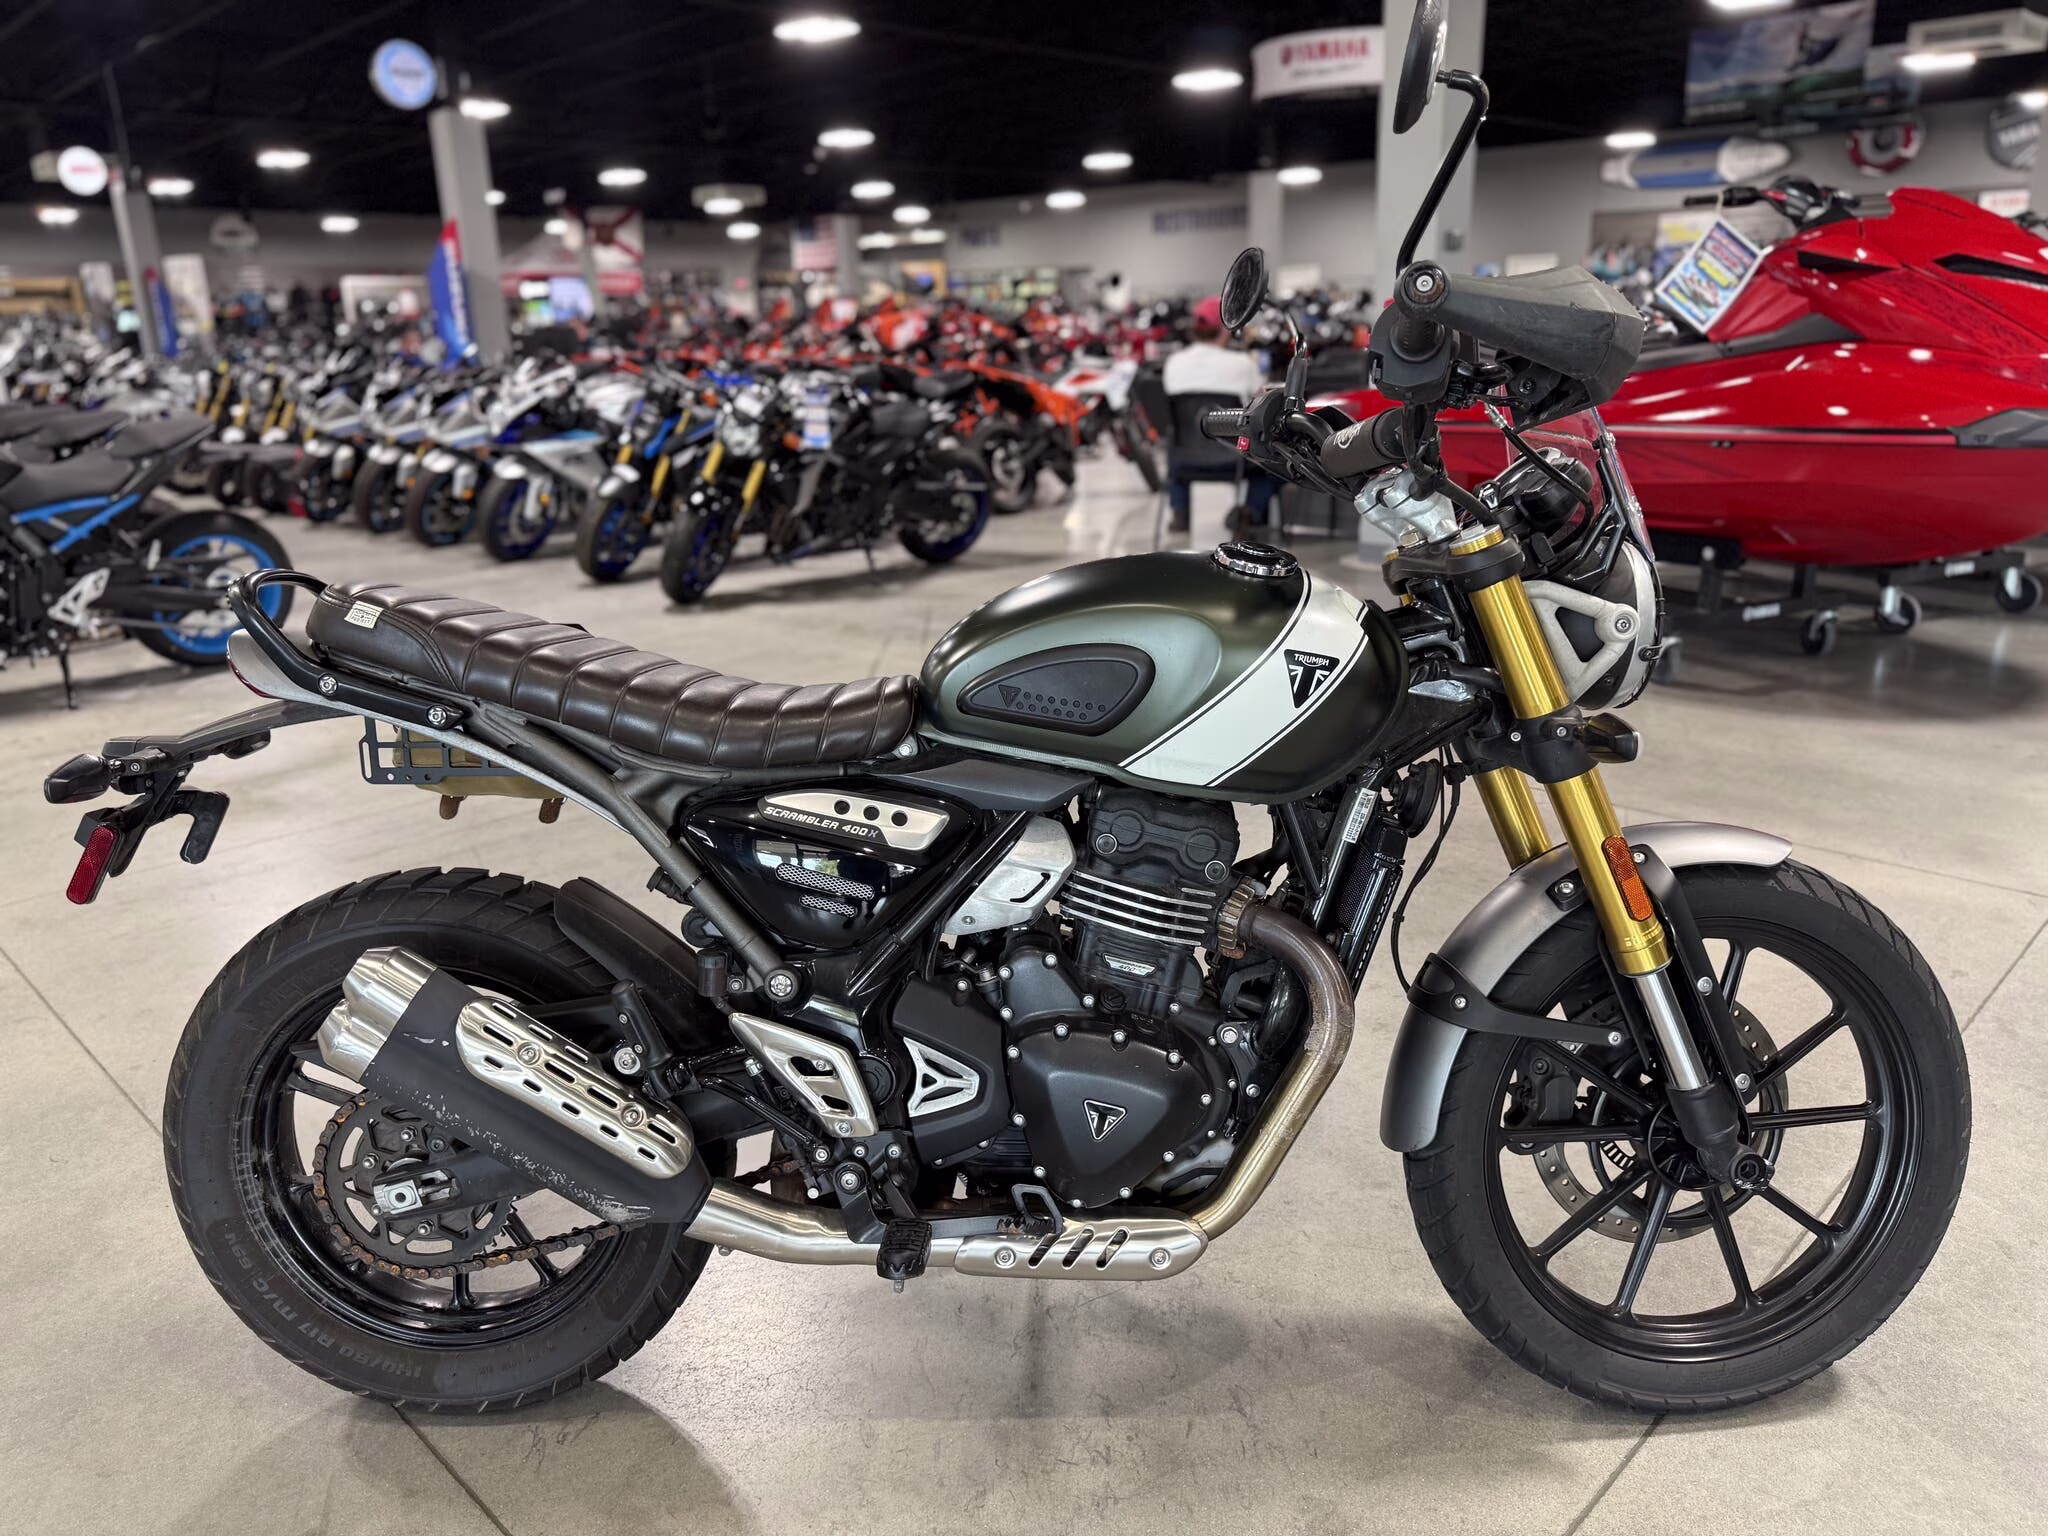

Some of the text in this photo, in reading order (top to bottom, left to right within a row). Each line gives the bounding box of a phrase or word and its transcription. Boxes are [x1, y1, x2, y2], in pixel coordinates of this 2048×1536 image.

[1293, 653, 1330, 667] TRIUMPH
[763, 806, 840, 830] SCRAMBLER
[252, 1277, 298, 1322] M/C
[297, 1321, 336, 1349] R17
